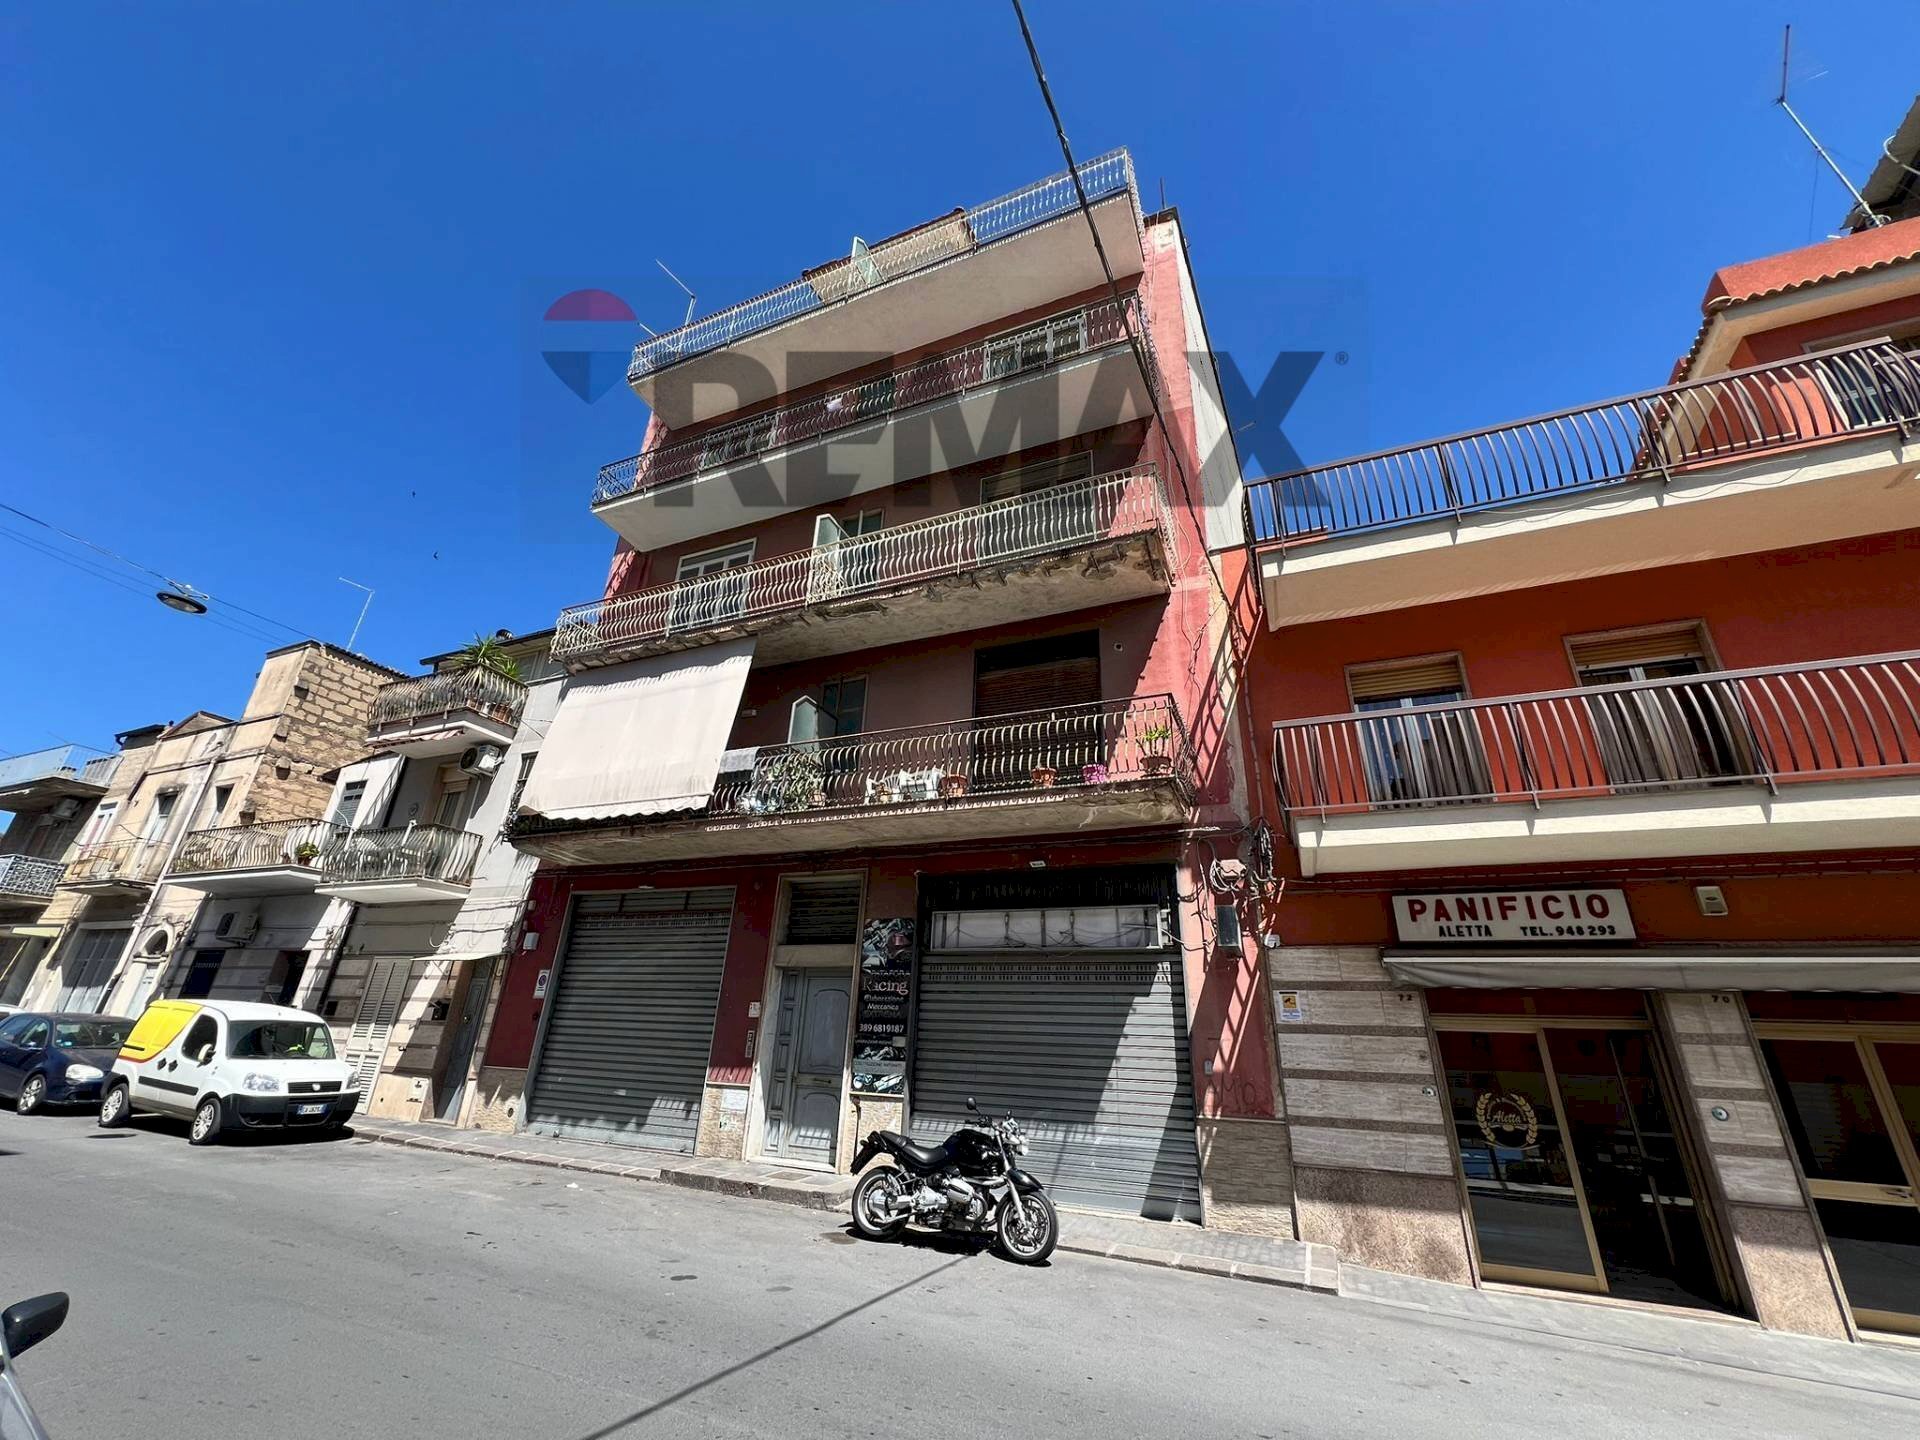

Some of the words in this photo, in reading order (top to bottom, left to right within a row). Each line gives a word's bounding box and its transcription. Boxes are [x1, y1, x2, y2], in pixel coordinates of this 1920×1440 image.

[1407, 894, 1610, 922] PANIFICIO
[1438, 925, 1493, 938] ALETTA
[1711, 994, 1730, 1004] 70
